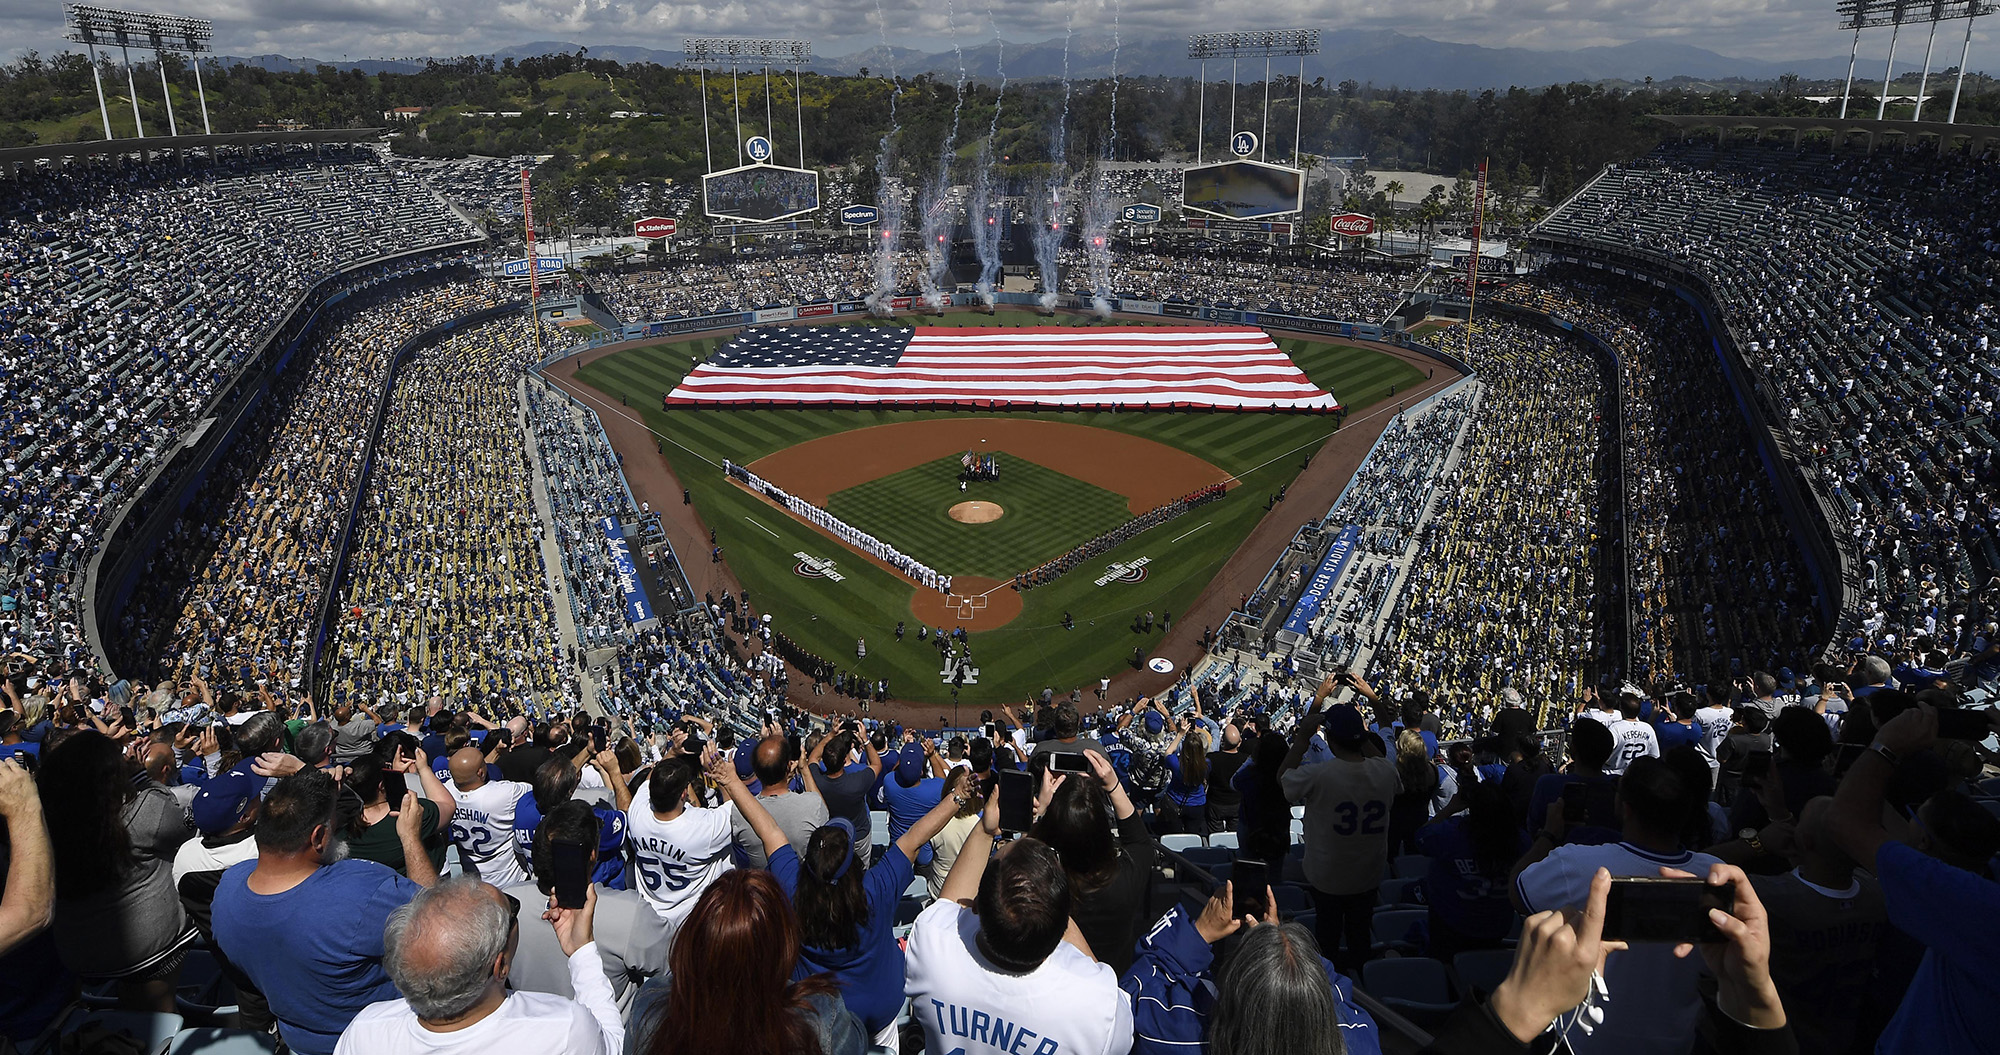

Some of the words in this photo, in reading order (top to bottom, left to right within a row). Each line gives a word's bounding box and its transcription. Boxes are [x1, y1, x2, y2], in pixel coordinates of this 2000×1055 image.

[754, 141, 765, 156] LA
[1237, 136, 1249, 152] LA
[844, 211, 874, 220] Spectrum
[540, 260, 561, 269] ROAD
[1457, 262, 1497, 271] JASCO
[680, 319, 715, 328] NATIONAL
[716, 316, 744, 324] ANTHEM
[1274, 318, 1309, 328] NATIONAL
[1311, 322, 1343, 332] ANTHEM
[793, 551, 827, 570] OPENING
[820, 567, 846, 583] WEEK
[1094, 566, 1131, 587] OPENING
[1125, 555, 1153, 570] WEEK
[1621, 730, 1650, 741] KERSHAW
[1622, 743, 1646, 760] 22
[1112, 753, 1130, 768] 74
[453, 808, 490, 824] RSHAW
[1333, 801, 1387, 836] 32
[632, 836, 687, 862] MARTIN
[636, 854, 692, 891] 55
[931, 998, 1059, 1055] TURNER
